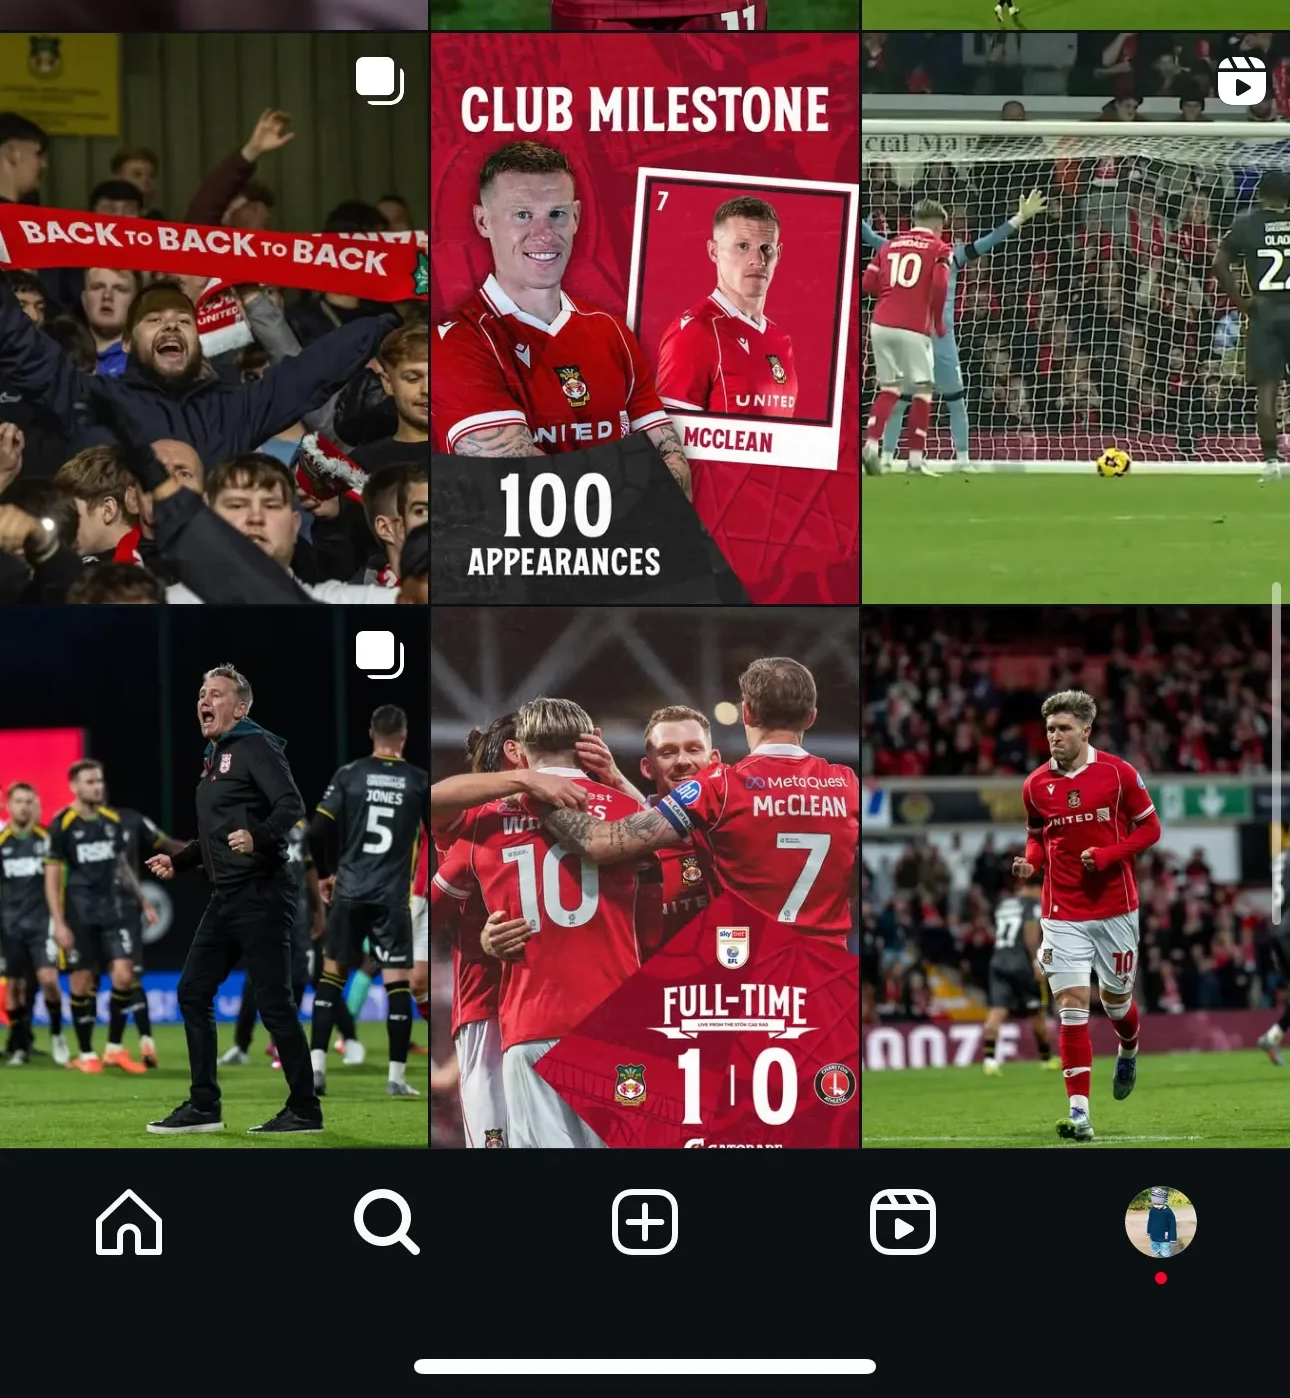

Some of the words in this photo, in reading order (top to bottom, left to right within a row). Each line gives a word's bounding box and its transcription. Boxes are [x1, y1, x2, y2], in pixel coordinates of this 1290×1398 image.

[720, 4, 755, 31] 11
[461, 86, 573, 133] CLUB
[588, 86, 830, 133] MILESTONE
[656, 191, 670, 211] 7
[19, 220, 123, 247] BACK
[157, 226, 258, 258] BACK
[293, 239, 389, 277] BACK
[887, 252, 922, 288] 10
[197, 305, 239, 325] UNITED
[736, 393, 796, 409] UNITED
[683, 426, 773, 453] MCCLEAN
[500, 472, 613, 538] 100
[467, 547, 661, 576] APPEARANCES
[366, 788, 404, 806] JONES
[678, 782, 698, 800] hp
[753, 794, 848, 817] McCLEAN
[362, 805, 395, 854] 5
[502, 840, 599, 933] 10
[776, 832, 832, 922] 7
[1112, 950, 1134, 976] 10
